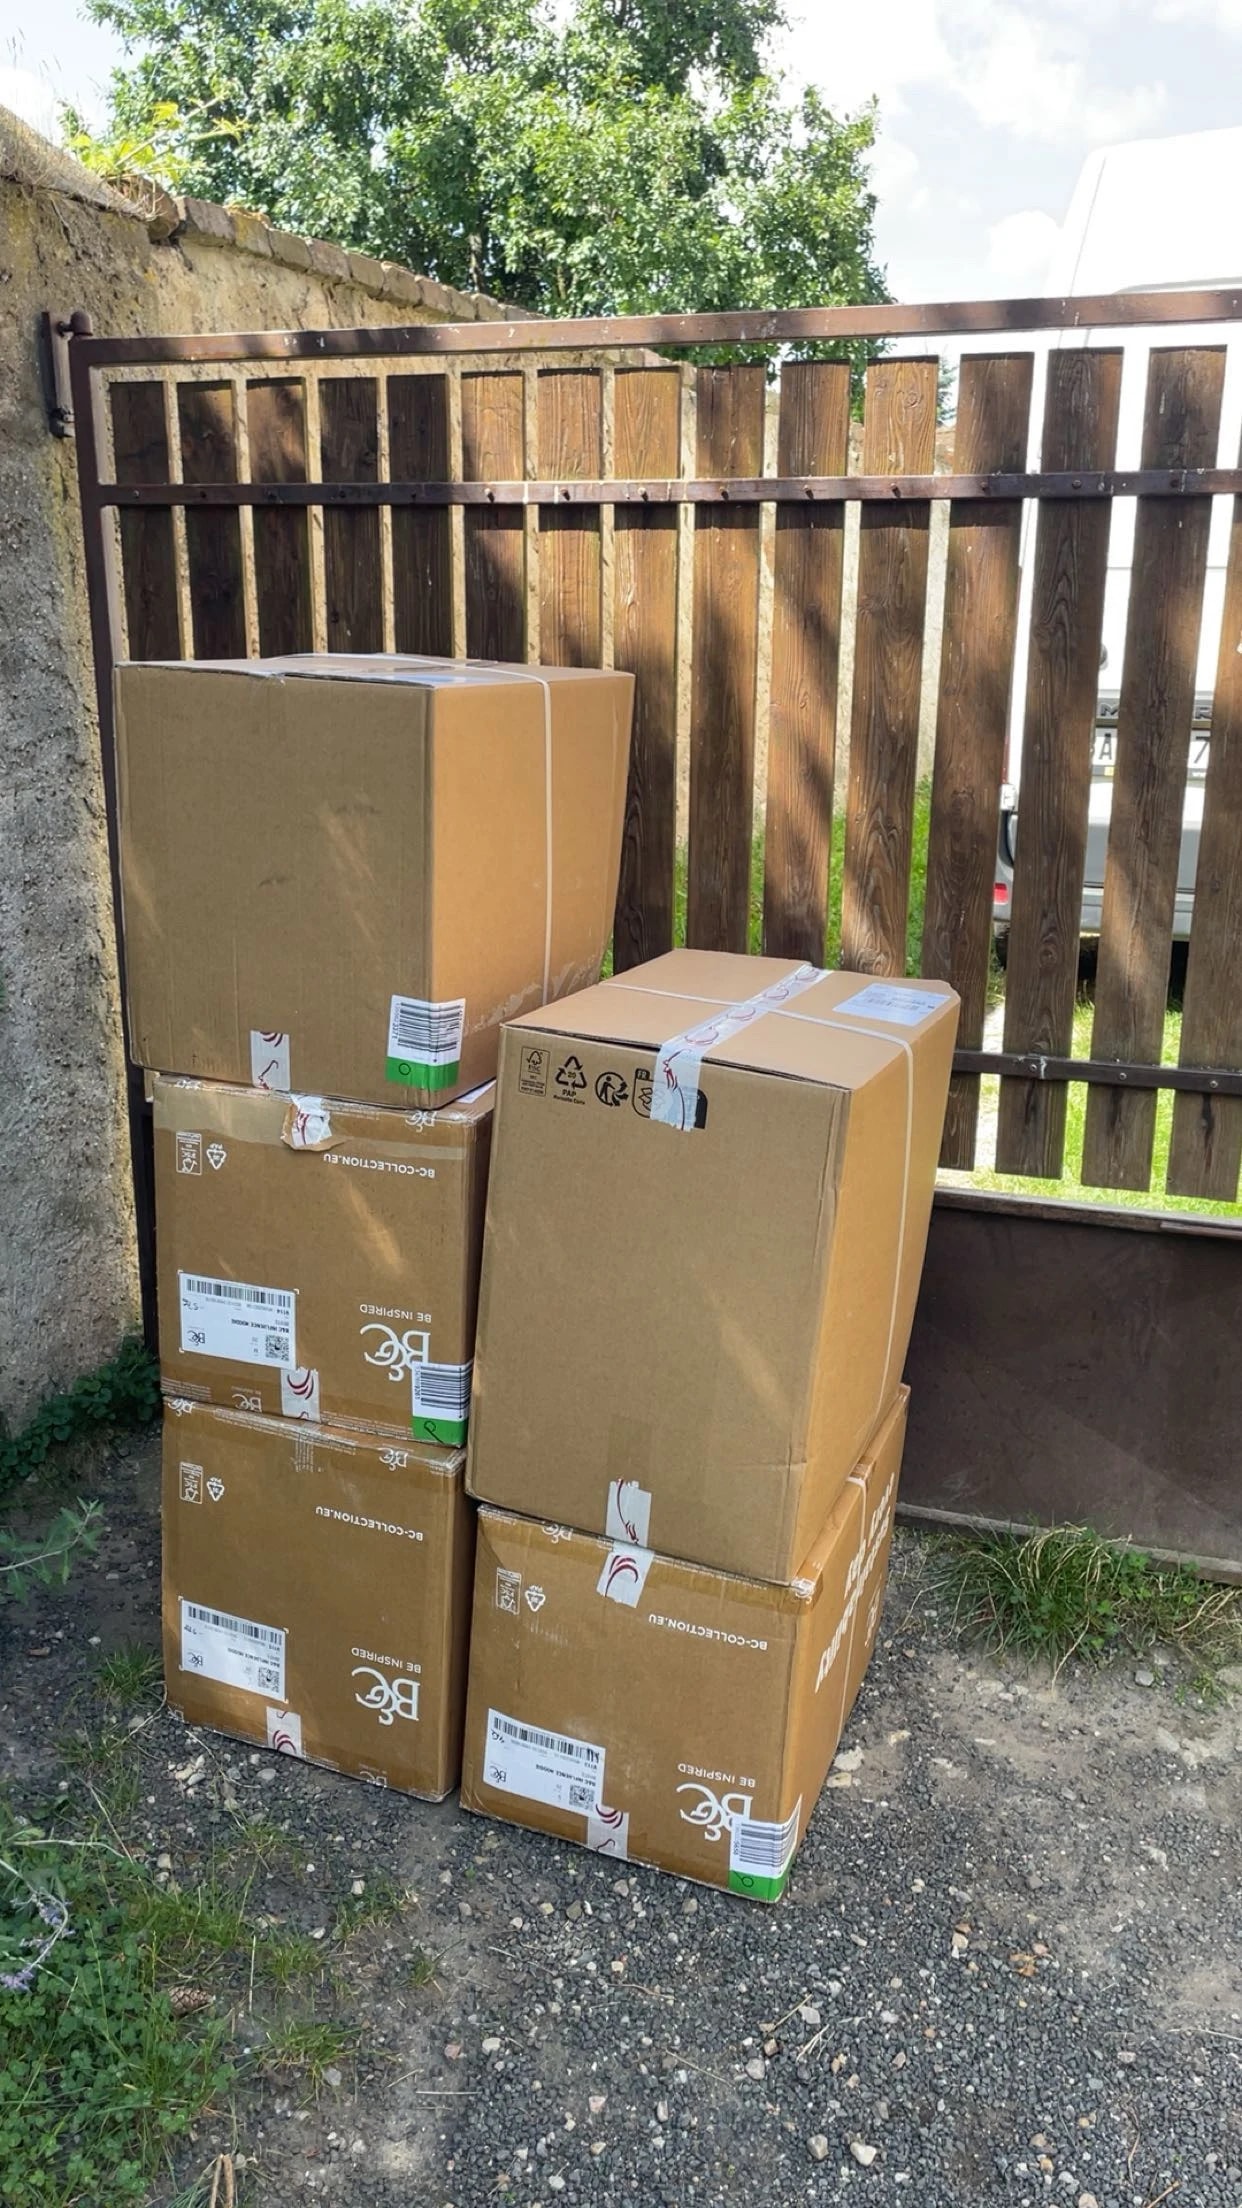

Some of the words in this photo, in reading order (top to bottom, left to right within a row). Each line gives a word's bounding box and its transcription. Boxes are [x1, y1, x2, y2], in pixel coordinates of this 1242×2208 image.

[323, 1153, 436, 1179] BC-COLLECTION.EU
[359, 1303, 414, 1321] INSPIRED
[416, 1312, 432, 1324] BE
[315, 1505, 424, 1542] BC-COLLECTION.EU
[648, 1613, 768, 1651] BC-COLLECTION.EU
[351, 1647, 403, 1669] INSPIRED
[406, 1661, 422, 1674] BE
[351, 1666, 421, 1726] B&C
[677, 1763, 736, 1784] INSPIRED
[738, 1776, 756, 1788] BE
